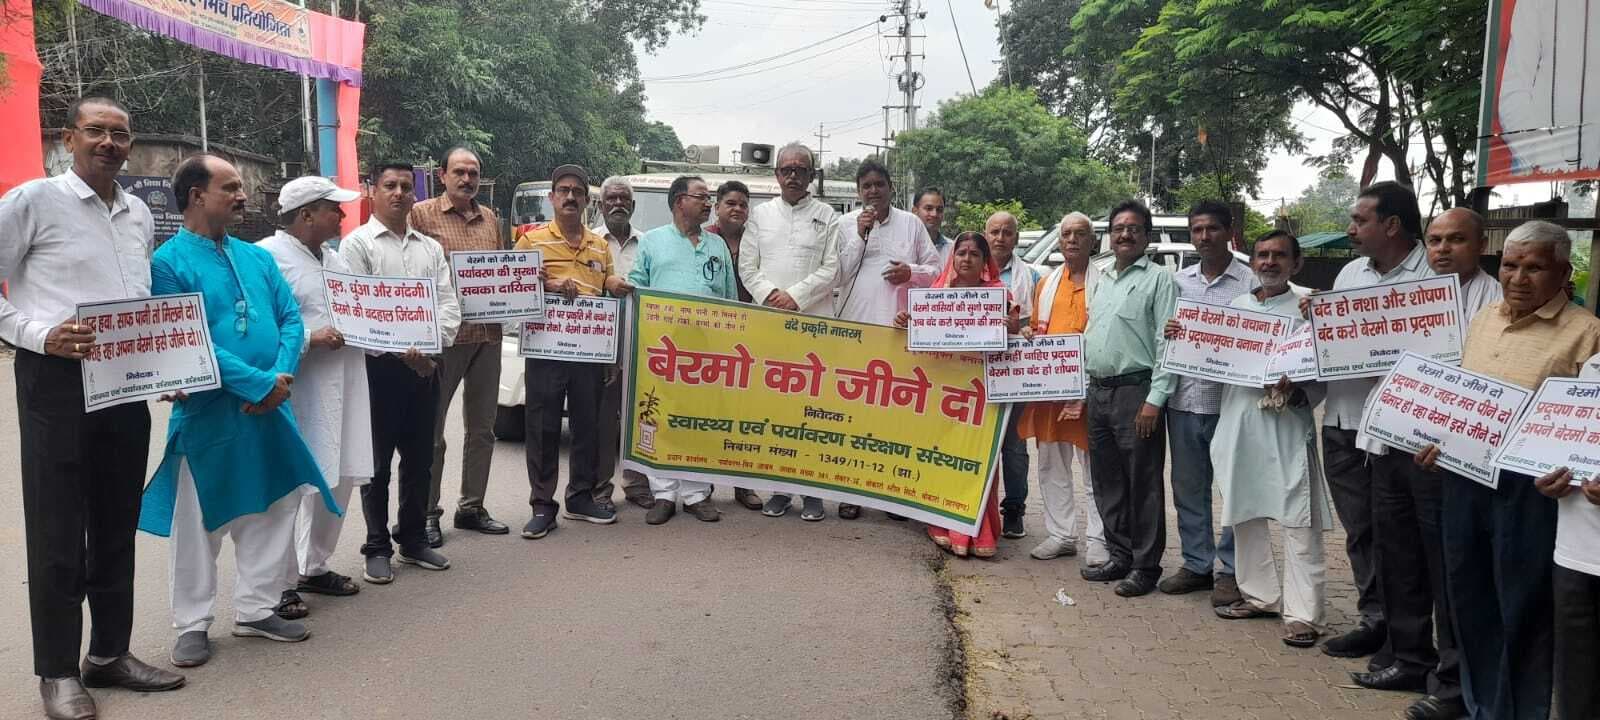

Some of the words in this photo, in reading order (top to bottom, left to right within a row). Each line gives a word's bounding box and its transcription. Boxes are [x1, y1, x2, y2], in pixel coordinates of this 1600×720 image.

[457, 266, 495, 278] पर्यावरण
[496, 265, 510, 276] की
[512, 267, 537, 280] सुरक्षा
[373, 281, 392, 297] और
[460, 285, 495, 296] सबका
[499, 281, 536, 293] दायित्व
[331, 299, 351, 315] बेरमो
[352, 302, 363, 318] की
[365, 308, 393, 322] बदहाल
[956, 300, 966, 312] की
[1313, 298, 1332, 317] बंद
[1335, 295, 1350, 317] हो
[1352, 296, 1378, 313] नशा
[1382, 288, 1406, 309] और
[117, 312, 133, 329] साफ
[135, 304, 150, 325] पानी
[152, 304, 160, 324] तो
[161, 301, 184, 323] मिलने
[912, 318, 925, 327] अब
[926, 316, 937, 326] बंद
[954, 318, 976, 331] प्रदूषण
[977, 315, 988, 326] की
[1177, 306, 1200, 322] अपने
[1201, 308, 1225, 326] बेरमो
[1226, 313, 1240, 329] को
[1242, 318, 1272, 334] बचाना
[582, 324, 591, 335] को
[606, 326, 613, 336] दो
[784, 317, 799, 330] वंदे
[801, 321, 828, 338] प्रकृति
[830, 326, 862, 344] मातरम्
[1317, 323, 1334, 341] बंद
[1336, 320, 1359, 339] करो
[1360, 315, 1388, 336] बेरमो
[1390, 318, 1407, 333] का
[103, 342, 114, 360] रहा
[116, 339, 136, 357] अपना
[137, 332, 153, 353] बेरमो
[155, 329, 167, 354] इसे
[168, 328, 185, 348] जीने
[1188, 329, 1235, 352] प्रदूषणमुक्त
[1236, 338, 1264, 352] बनाना
[1004, 349, 1022, 362] नहीं
[1024, 349, 1049, 360] चाहिए
[1051, 350, 1079, 364] प्रदूषण
[647, 335, 755, 389] बेरमो
[764, 352, 826, 398] को
[835, 359, 932, 414] जीने
[941, 377, 986, 426] दो
[989, 366, 1010, 377] बेरमो
[1012, 367, 1024, 376] का
[1027, 364, 1040, 375] बंद
[1042, 363, 1051, 375] हो
[1055, 363, 1079, 374] शोषण
[1417, 363, 1444, 378] बेरमो
[1444, 374, 1461, 385] को
[1462, 378, 1488, 393] जीने
[1489, 387, 1504, 399] दो
[1390, 373, 1421, 392] प्रदूषण
[1419, 382, 1434, 395] का
[1434, 387, 1459, 405] जहर
[1458, 396, 1477, 411] मत
[1477, 399, 1499, 419] पीने
[1498, 408, 1512, 424] दो
[1566, 385, 1600, 398] बेरमो
[804, 406, 845, 422] निवेदक
[1401, 398, 1414, 413] हो
[1413, 403, 1428, 419] रहा
[1427, 406, 1451, 427] बेरमो
[1450, 417, 1467, 433] इसे
[1467, 422, 1489, 442] जीने
[1489, 430, 1501, 447] दो
[1536, 402, 1575, 421] प्रदूषण
[1575, 406, 1595, 419] का
[1522, 422, 1555, 438] अपने
[1555, 423, 1587, 443] बेरमो
[668, 414, 733, 433] स्वास्थ्य
[739, 418, 770, 435] एवं
[771, 422, 847, 447] पर्यावरण
[851, 433, 912, 459] संरक्षण
[917, 445, 982, 475] संस्थान
[724, 439, 761, 453] निबंधन
[768, 443, 797, 458] संख्या
[819, 453, 885, 473] 1349/11-12
